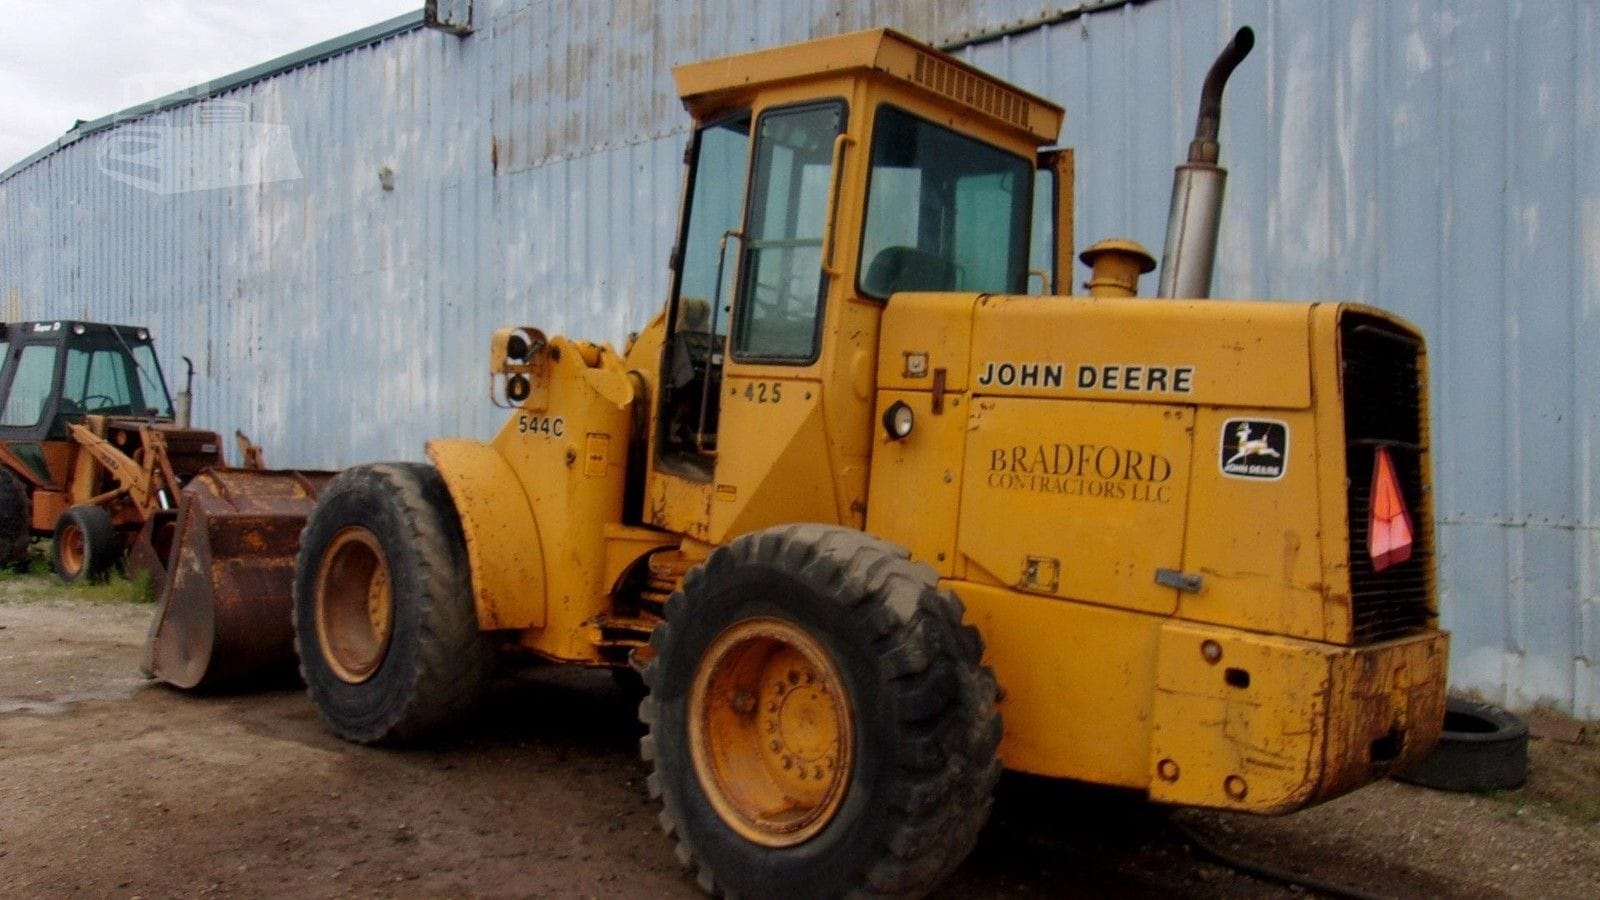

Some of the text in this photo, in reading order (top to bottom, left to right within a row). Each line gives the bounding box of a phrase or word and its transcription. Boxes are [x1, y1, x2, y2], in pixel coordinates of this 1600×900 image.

[979, 363, 1193, 392] JOHN DEERE
[744, 382, 782, 404] 425
[519, 415, 564, 437] 544C
[990, 444, 1172, 483] BRADFORD
[1224, 463, 1248, 474] JOHN
[987, 472, 1171, 503] CONTRACTORS LLC
